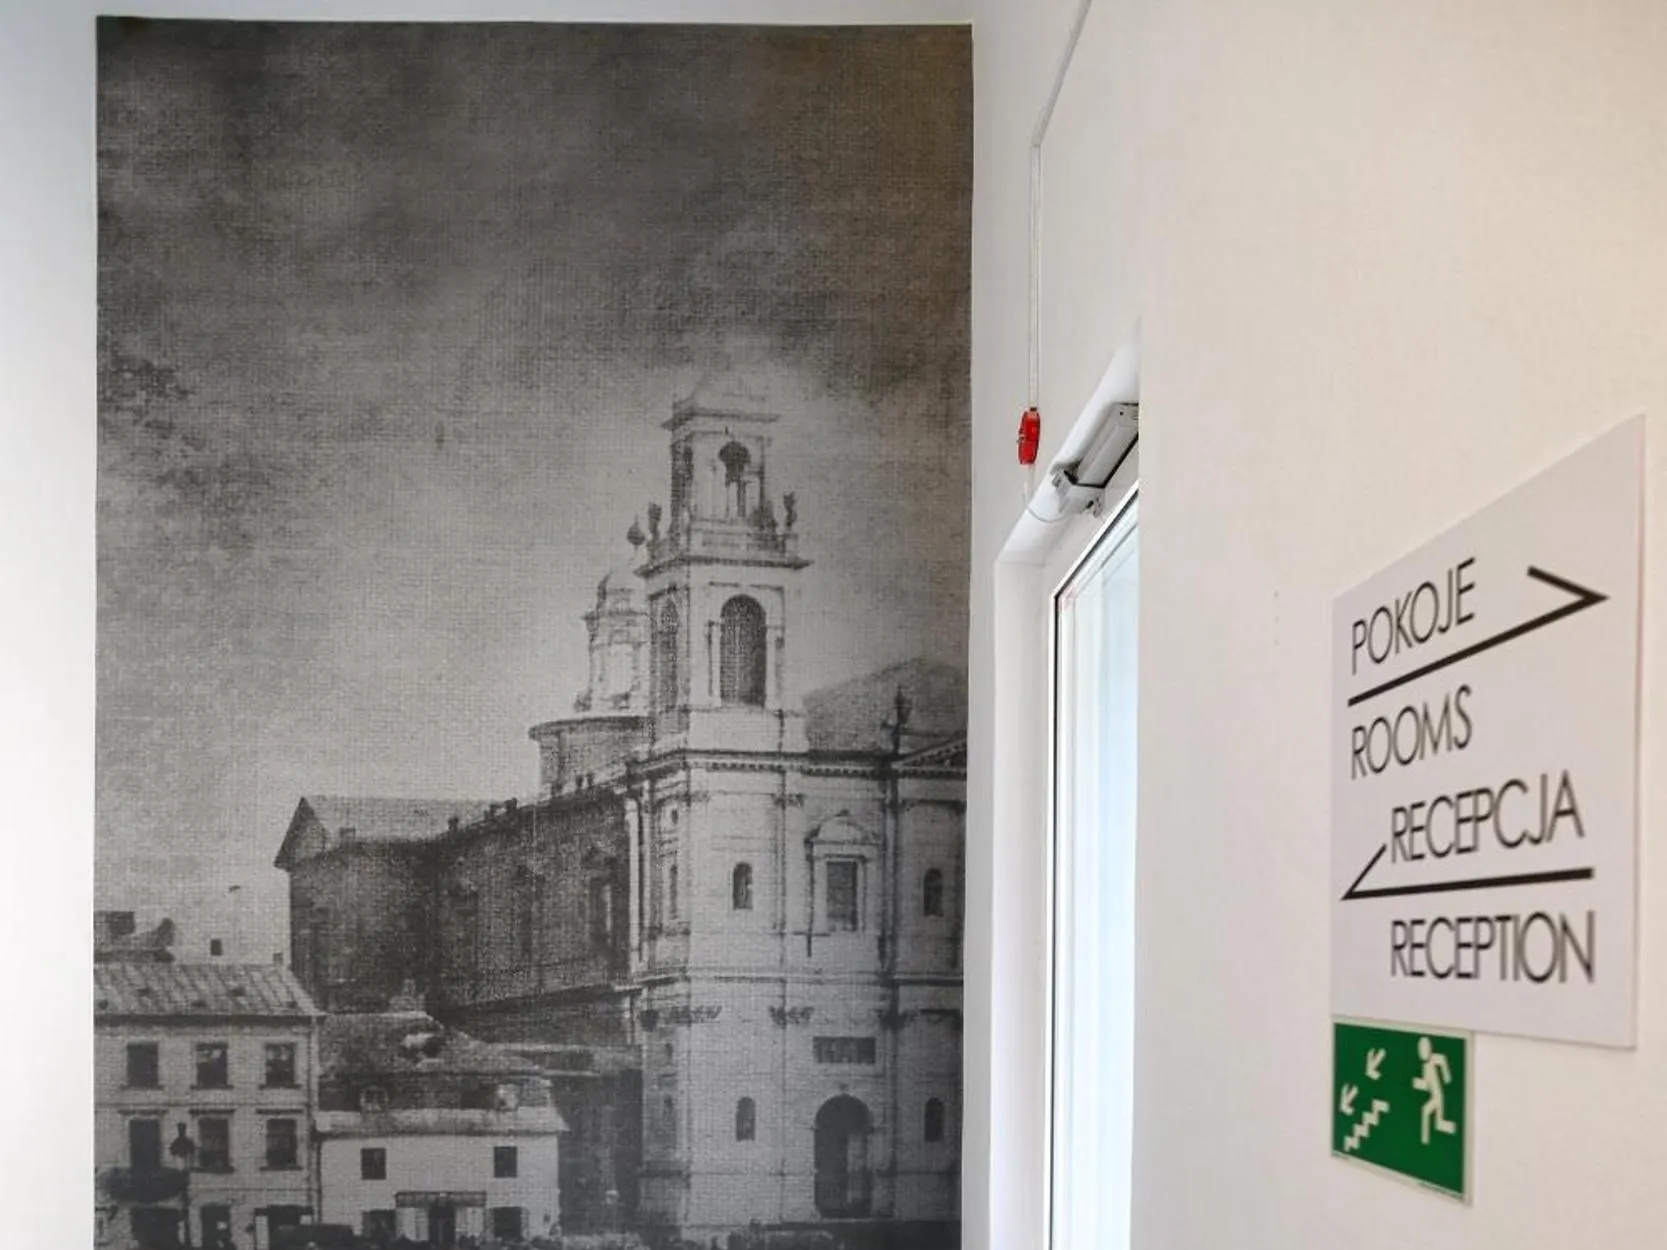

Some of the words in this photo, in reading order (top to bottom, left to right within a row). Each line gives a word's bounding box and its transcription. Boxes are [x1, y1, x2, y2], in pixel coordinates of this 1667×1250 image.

[1351, 556, 1477, 675] POKOJE
[1351, 683, 1473, 780] ROOMS
[1391, 769, 1585, 864] RECEPCJA
[1390, 910, 1595, 985] RECEPTION
